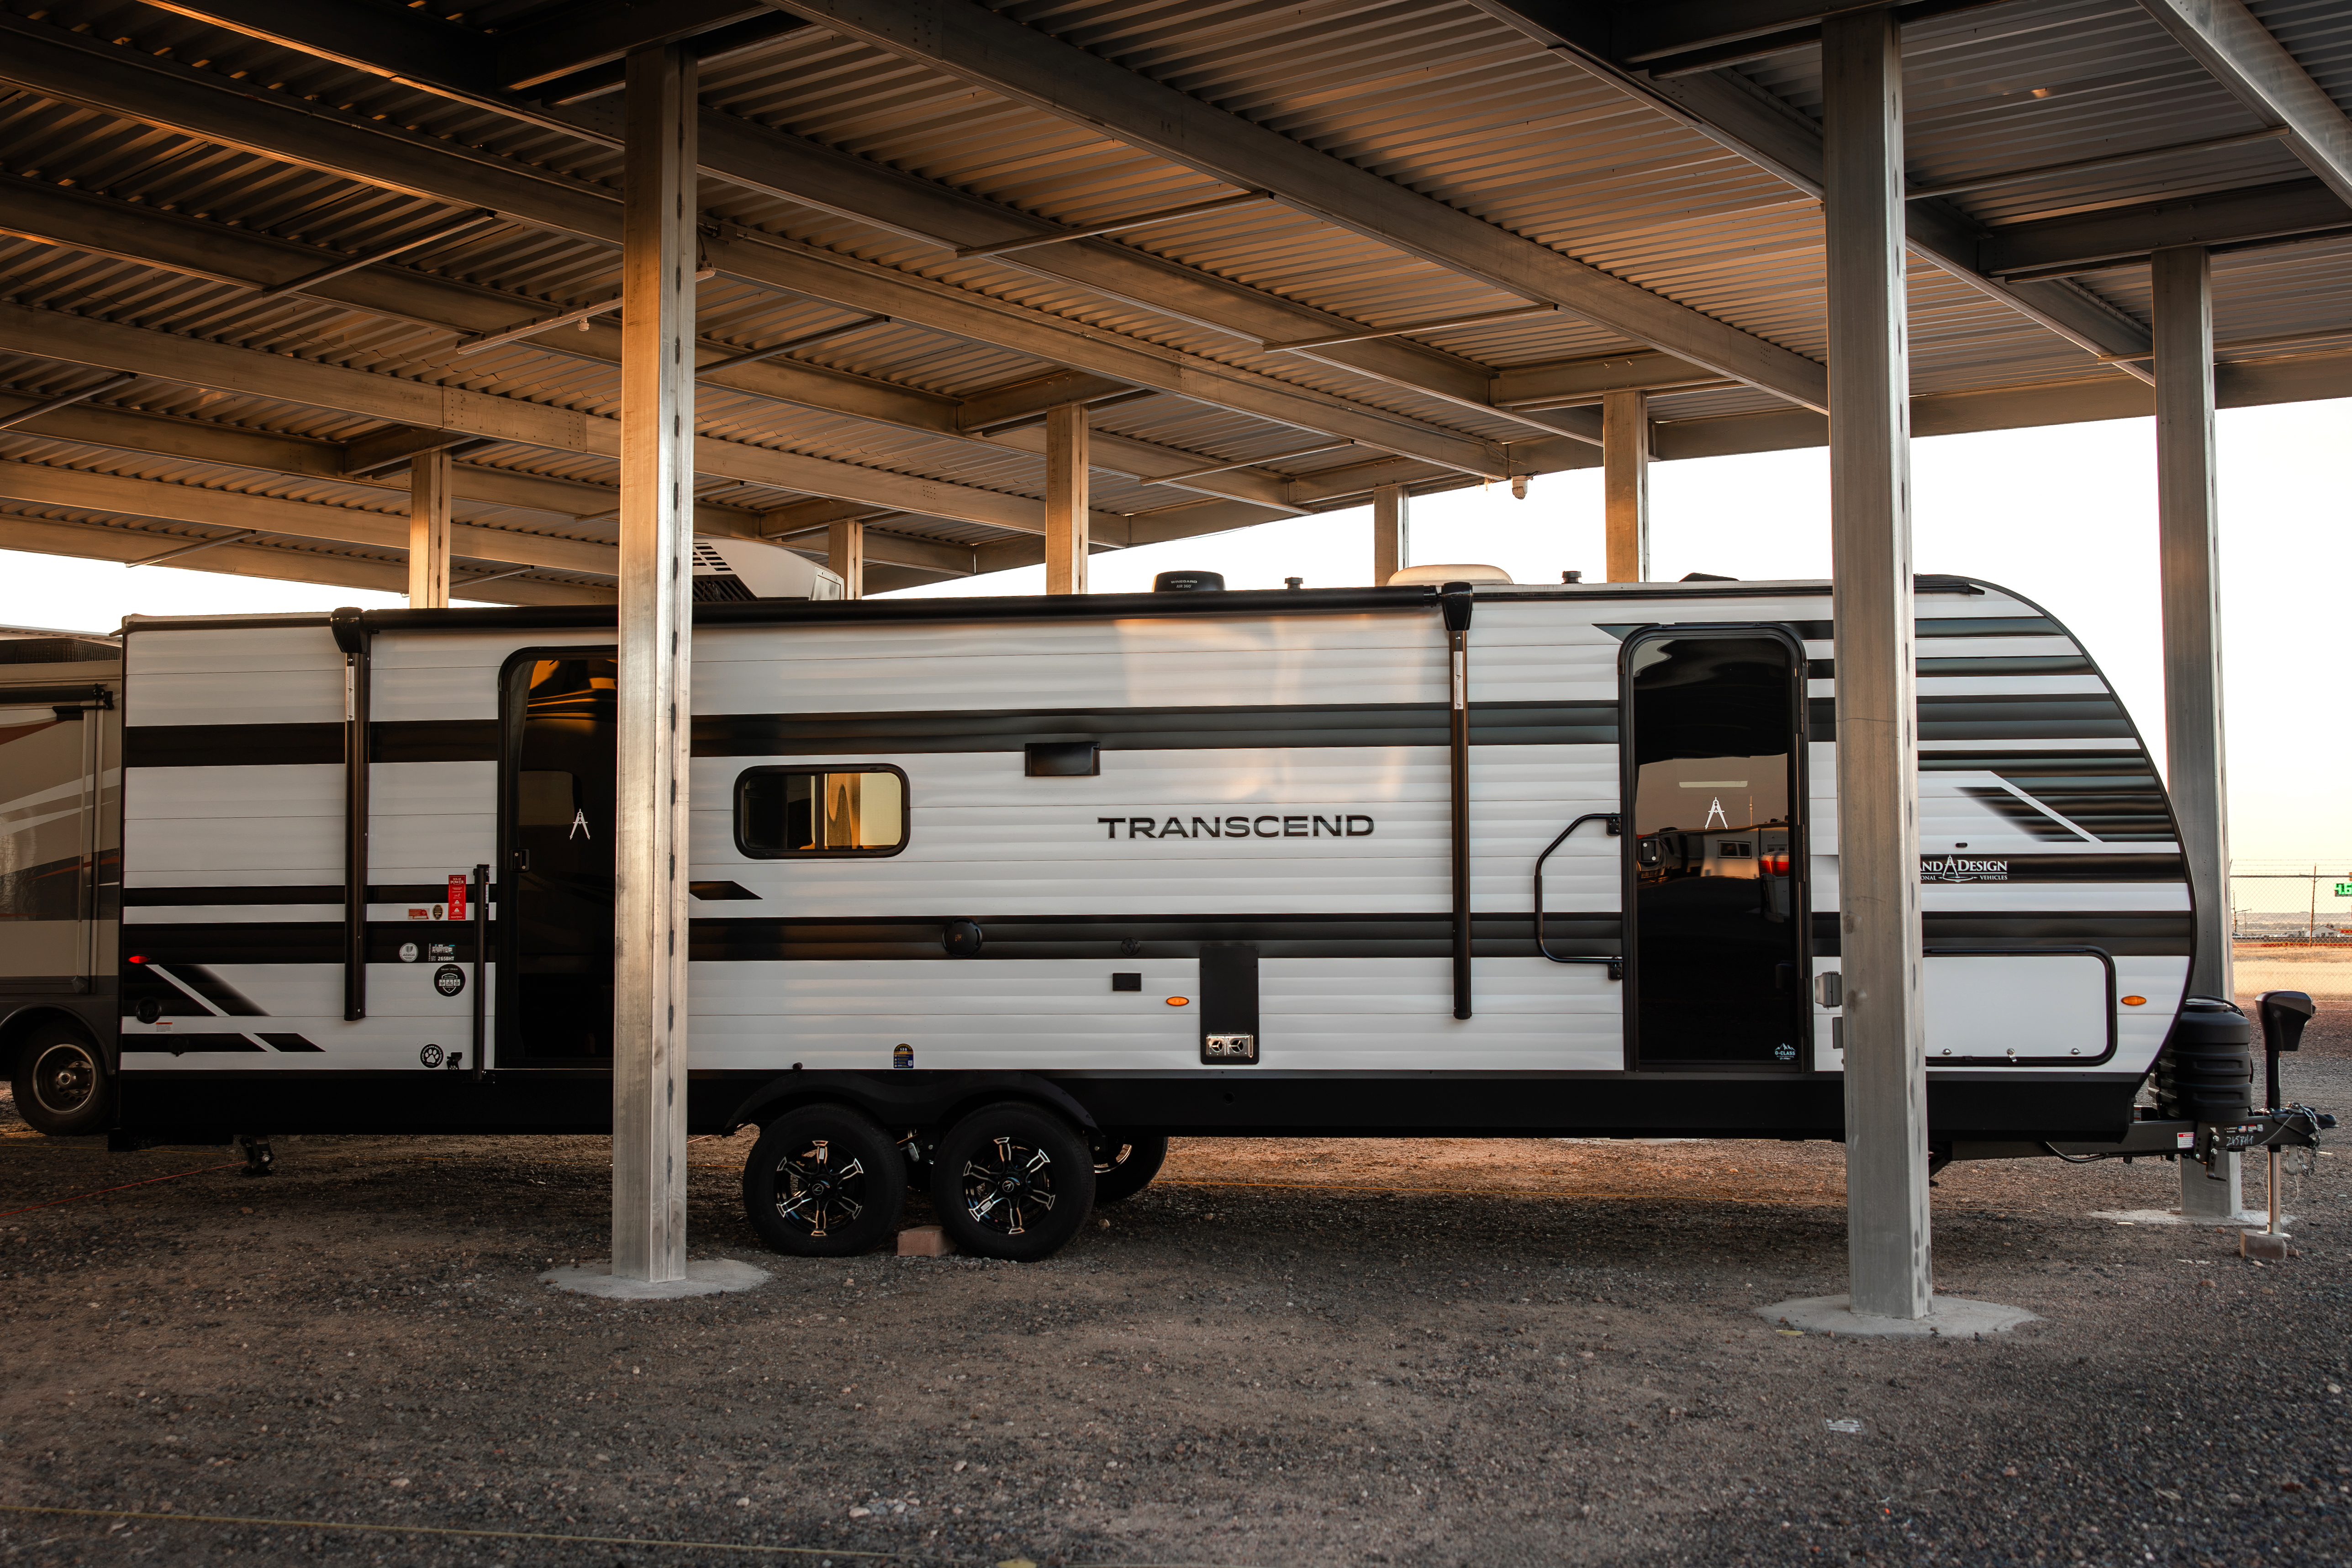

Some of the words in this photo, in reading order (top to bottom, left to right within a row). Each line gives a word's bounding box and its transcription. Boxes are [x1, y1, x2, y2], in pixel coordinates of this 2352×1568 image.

[1097, 814, 1375, 839] TRANSCEND
[1957, 860, 2008, 871] DESIGN
[2334, 883, 2352, 895] 4.6
